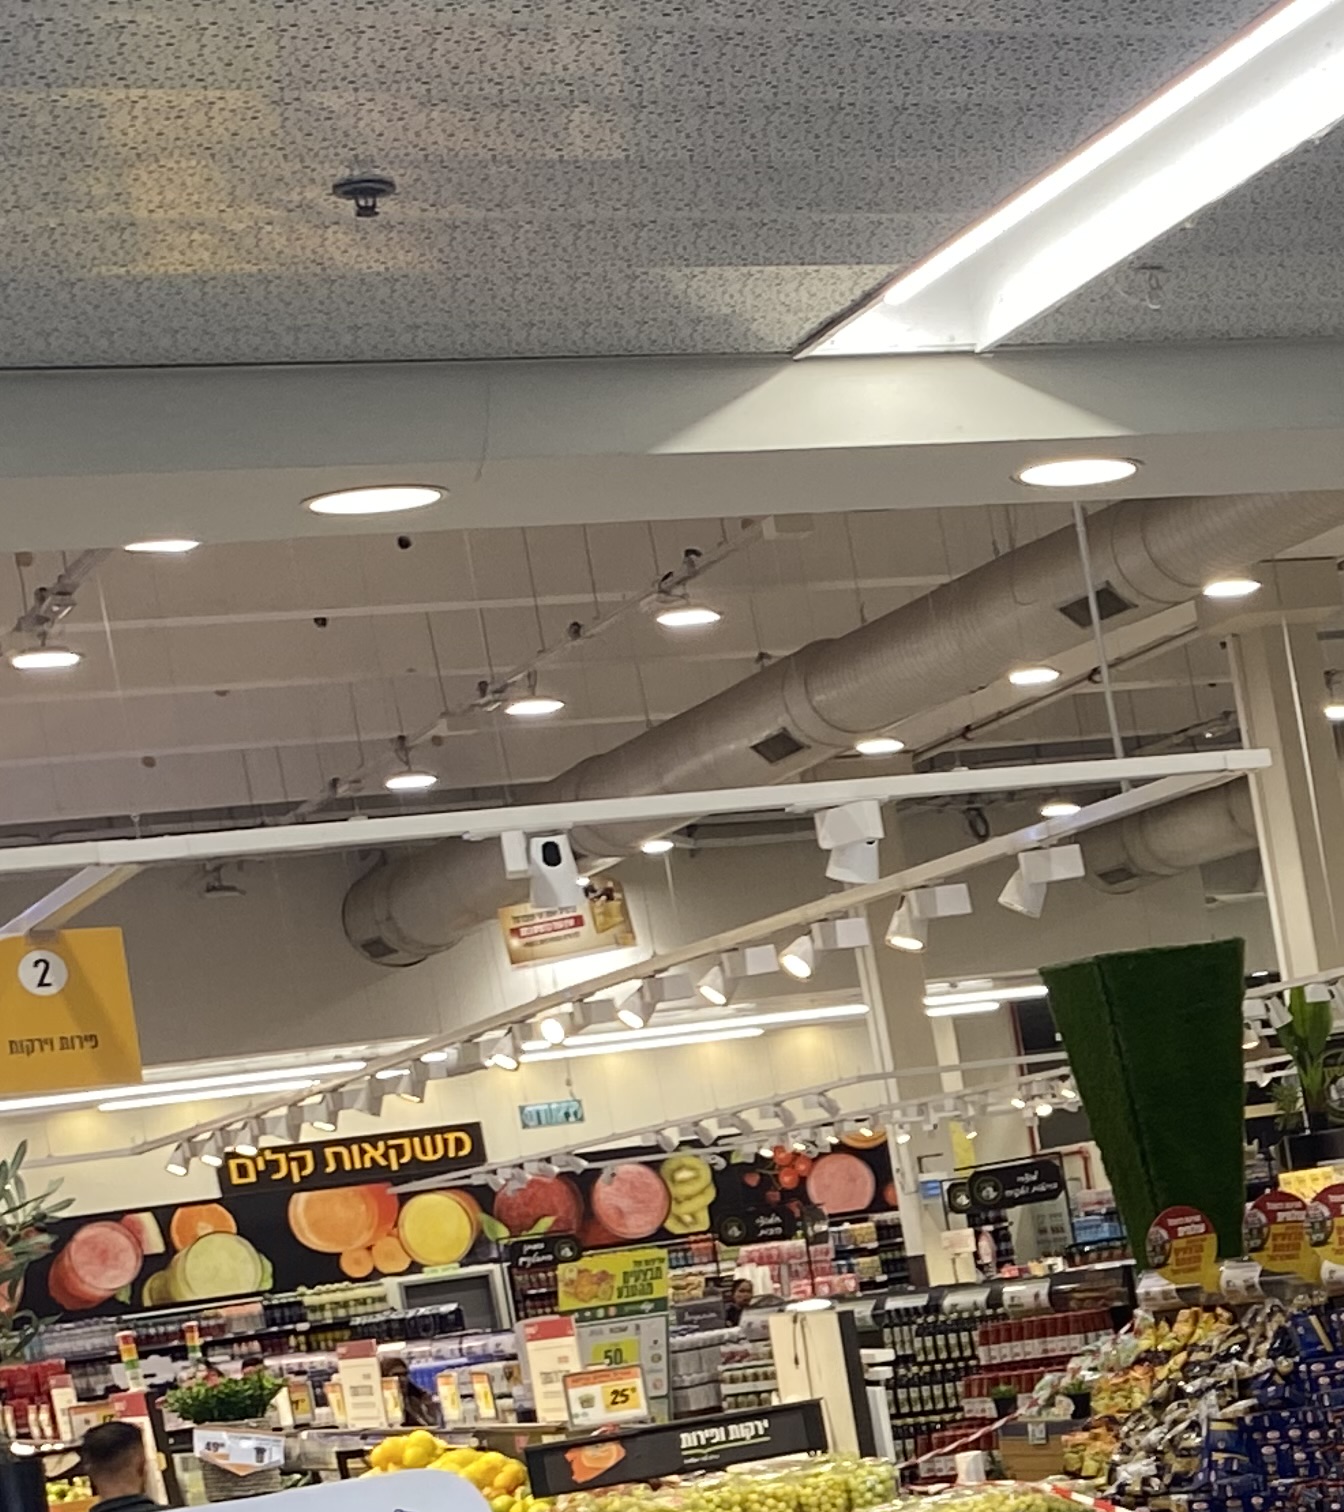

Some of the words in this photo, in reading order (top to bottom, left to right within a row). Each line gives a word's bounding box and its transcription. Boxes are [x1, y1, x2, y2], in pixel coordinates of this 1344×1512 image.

[32, 958, 53, 988] 2
[8, 1037, 55, 1057] וירקות
[58, 1033, 99, 1051] פירות
[324, 1130, 473, 1173] משקאות
[228, 1149, 316, 1186] קלים
[679, 1426, 727, 1449] ופירות
[727, 1418, 770, 1441] ירקות
